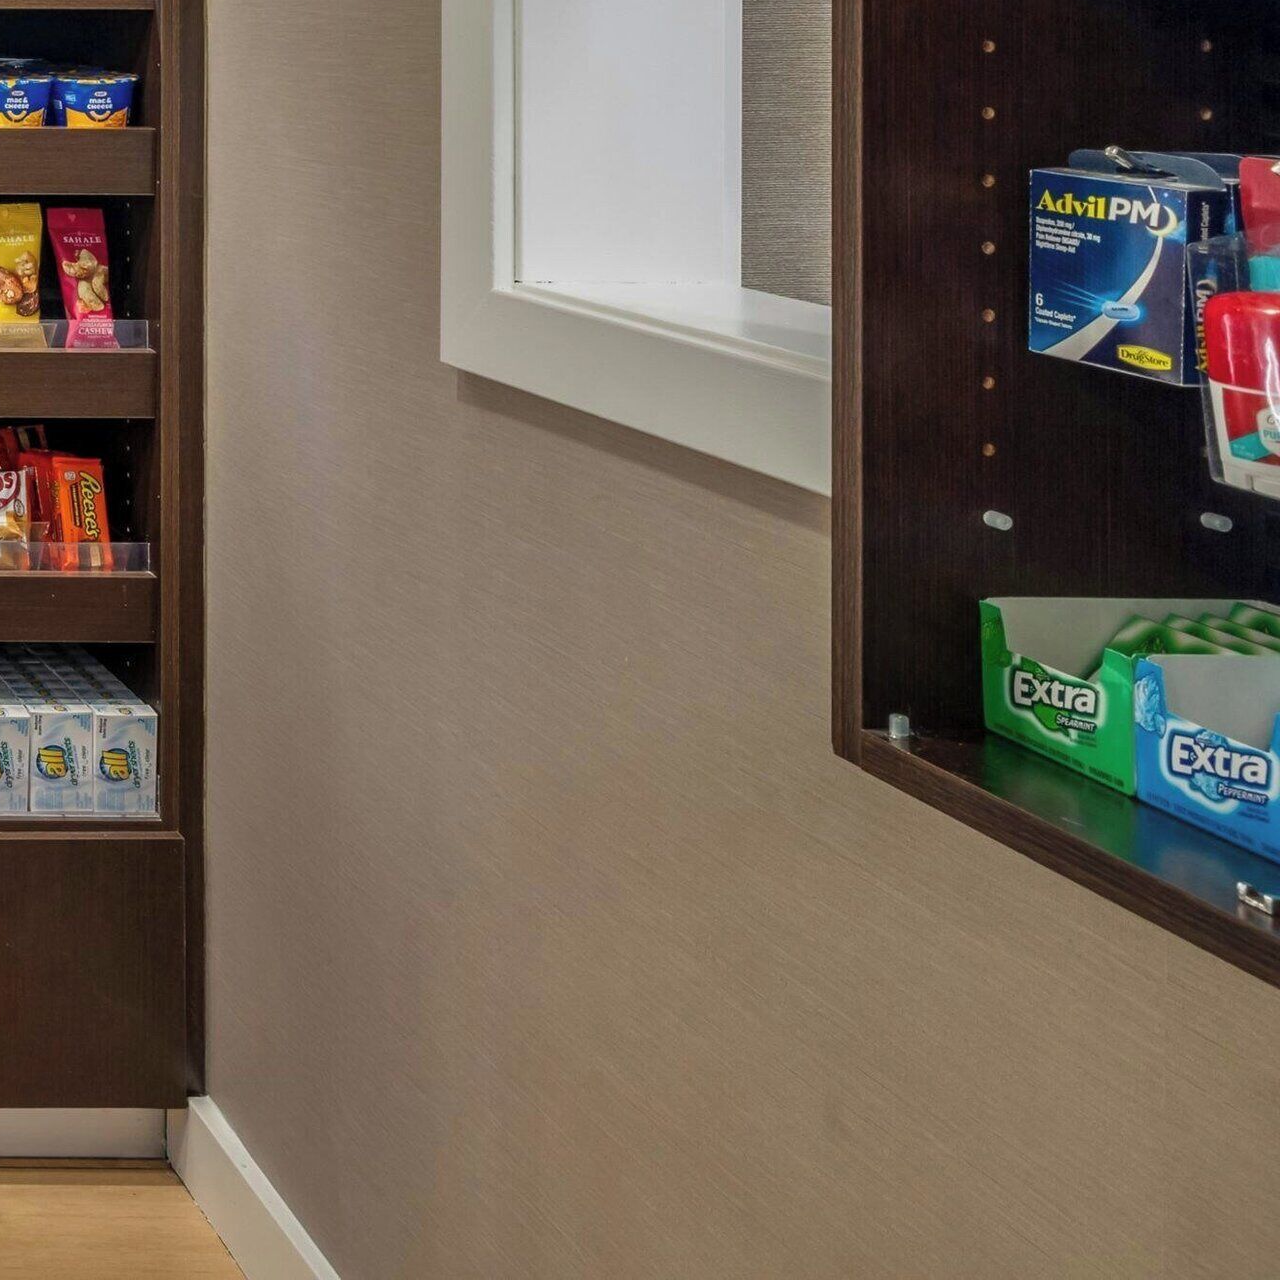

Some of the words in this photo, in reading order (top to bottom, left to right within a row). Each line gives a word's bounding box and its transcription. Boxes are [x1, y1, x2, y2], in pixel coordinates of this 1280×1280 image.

[1036, 188, 1108, 220] Advil
[1107, 196, 1160, 228] PM
[62, 235, 102, 245] SAHALE
[1035, 292, 1044, 307] 6
[1118, 347, 1171, 369] DrugStore
[79, 471, 102, 542] Reese's
[1012, 670, 1096, 714] Extra
[1055, 714, 1096, 733] SPEARMINT
[1171, 737, 1268, 786] Extra
[1216, 783, 1269, 806] PEPPERMINT
